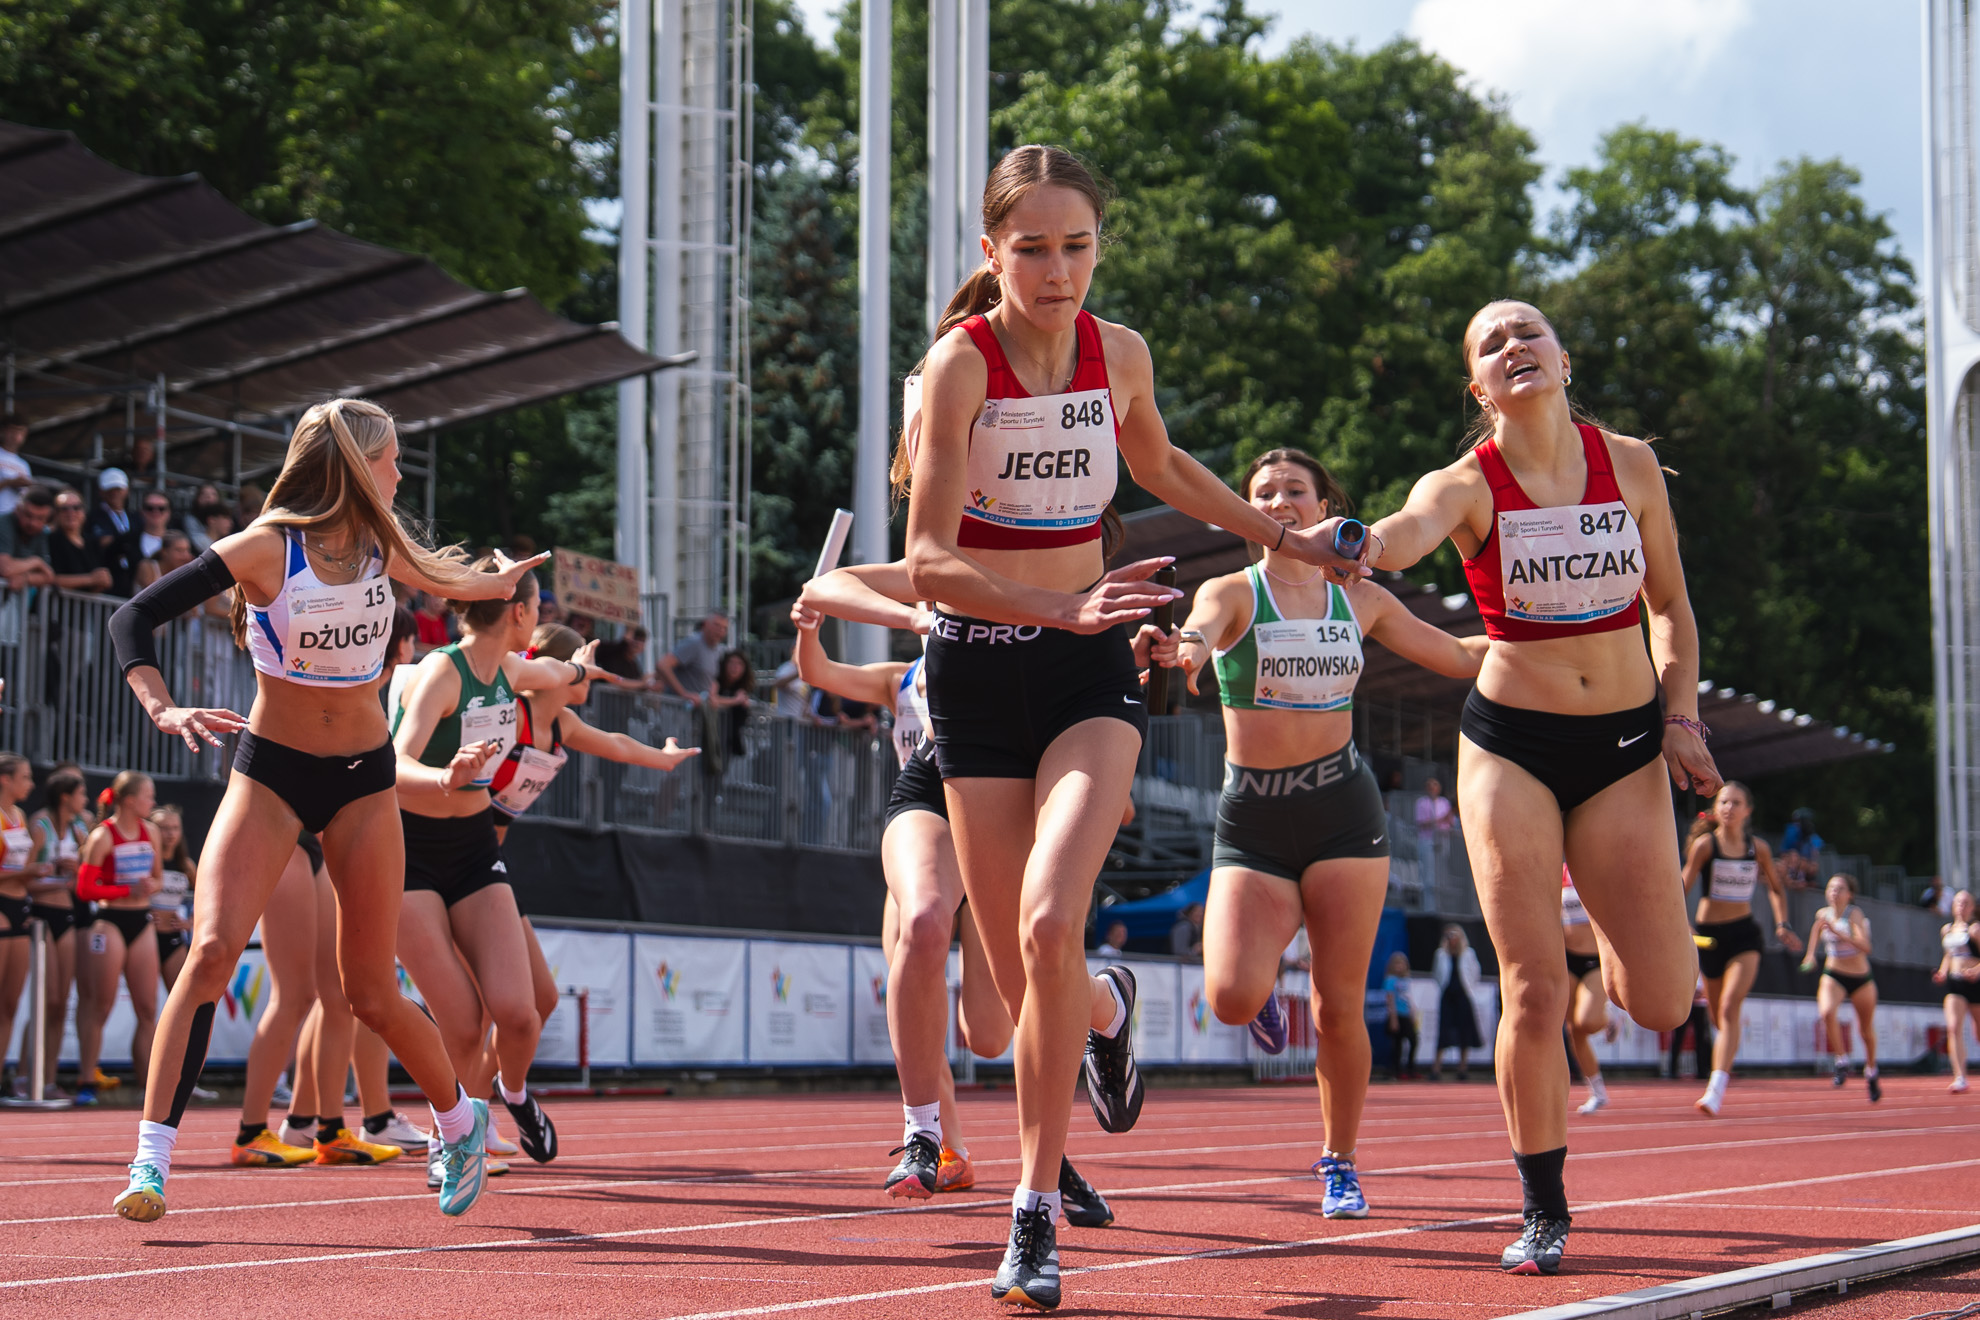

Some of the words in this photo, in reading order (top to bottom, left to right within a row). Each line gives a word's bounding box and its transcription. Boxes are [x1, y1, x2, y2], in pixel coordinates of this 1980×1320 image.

[1023, 416, 1045, 424] Turystyki
[1061, 400, 1104, 429] 848
[998, 448, 1091, 480] JEGER
[984, 513, 1016, 525] POZNAŃ
[1541, 524, 1564, 532] Turystyki
[1579, 509, 1627, 536] 847
[1508, 548, 1640, 585] ANTCZAK
[364, 584, 386, 608] 15
[299, 616, 389, 650] DŻUGAJ
[967, 624, 1042, 645] PRO
[1317, 626, 1351, 643] 154
[1261, 655, 1359, 678] PIOTROWSKA
[1237, 754, 1343, 797] NIKE
